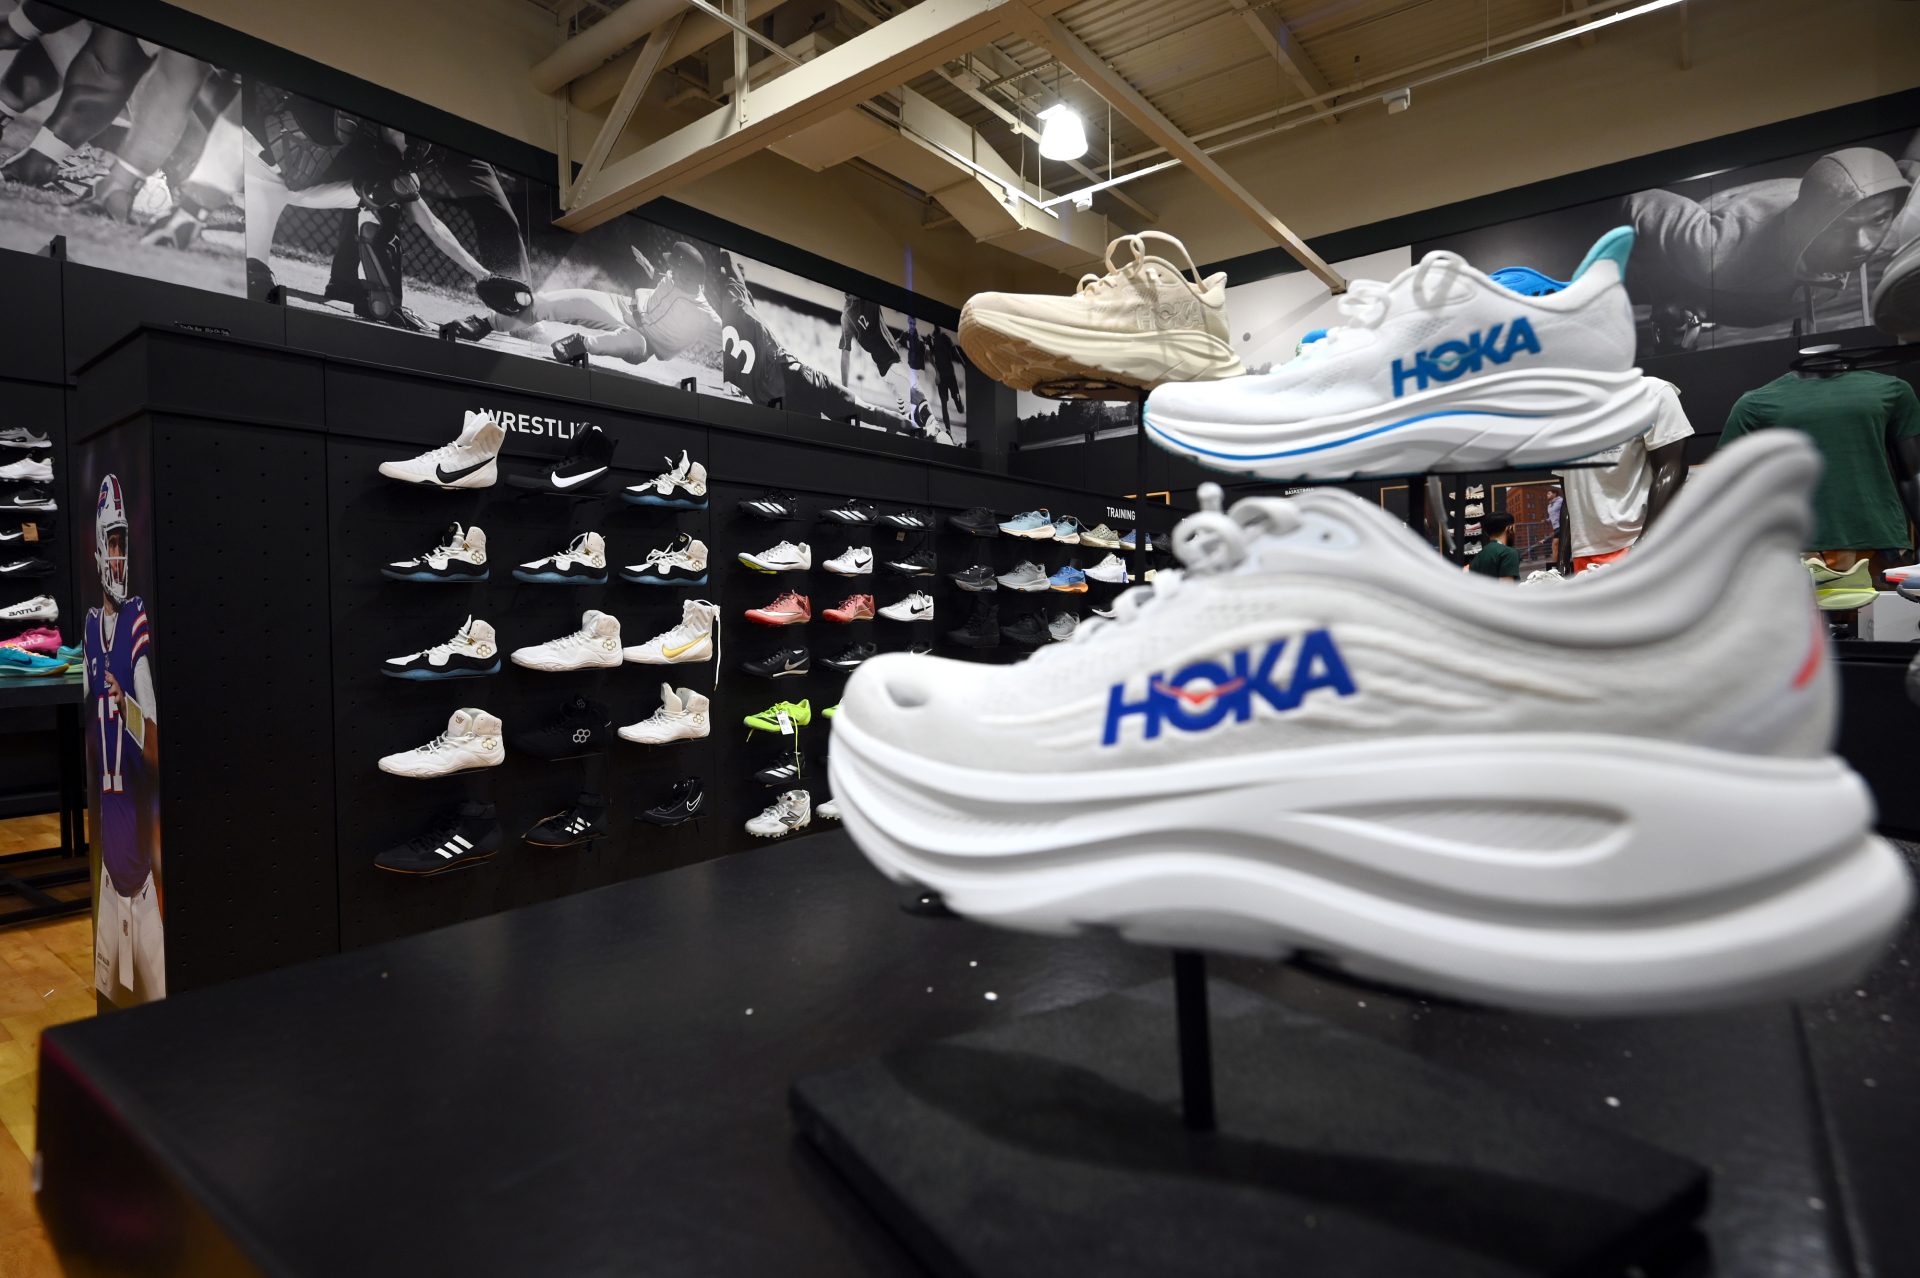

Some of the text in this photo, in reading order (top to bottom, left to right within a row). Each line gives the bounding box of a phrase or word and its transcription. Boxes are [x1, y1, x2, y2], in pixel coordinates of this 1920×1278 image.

[857, 315, 869, 329] 12
[1137, 300, 1205, 331] HOKA
[722, 325, 756, 374] 3
[1391, 316, 1542, 398] HOKA
[479, 407, 603, 440] WRESTLI
[1106, 506, 1136, 521] TRAINING
[8, 605, 42, 617] BATTLE
[1101, 627, 1357, 746] HOKA
